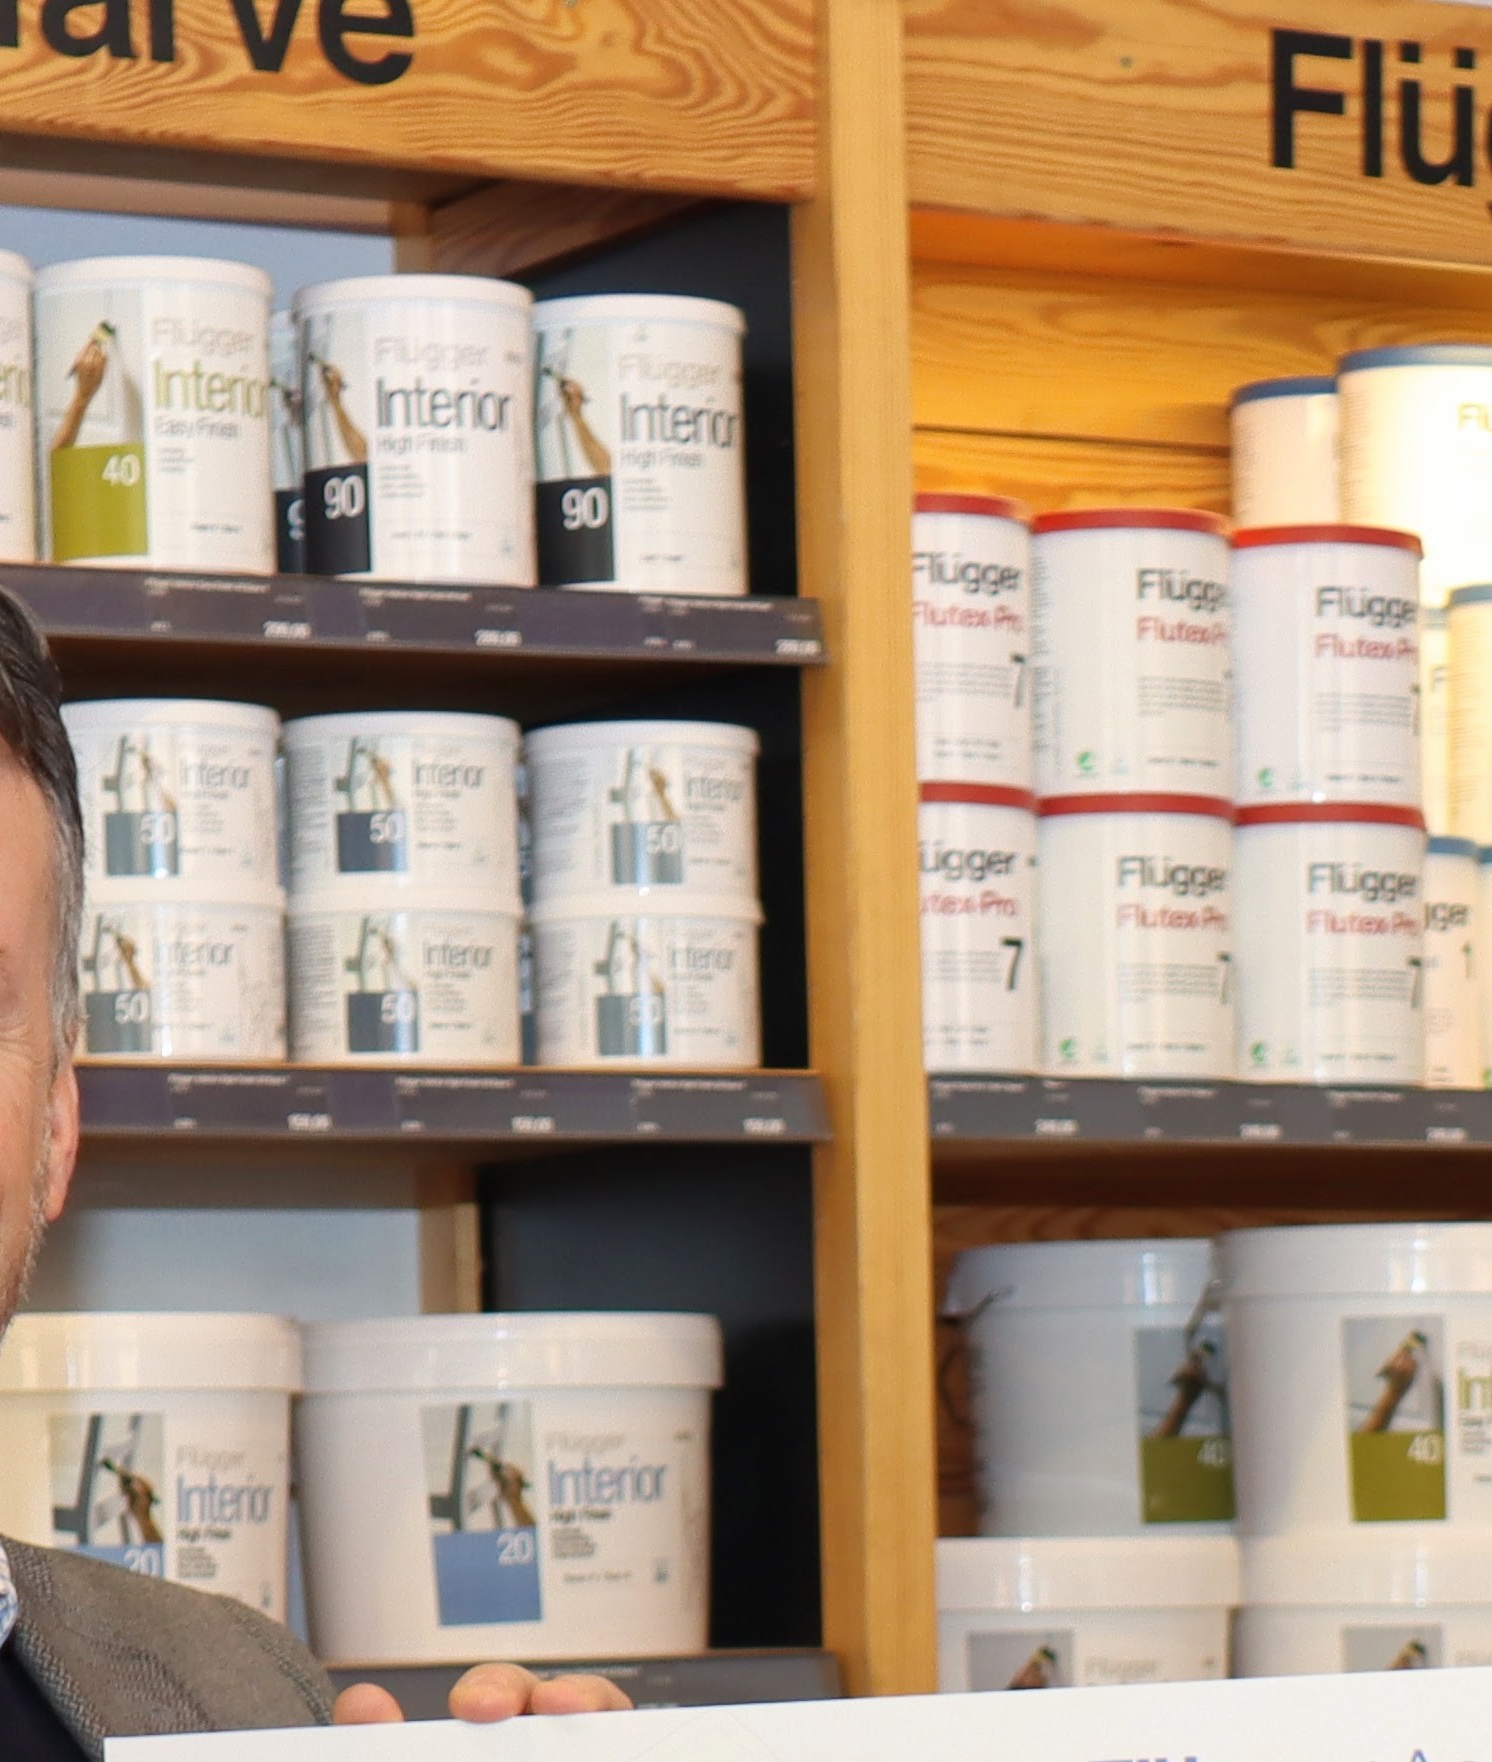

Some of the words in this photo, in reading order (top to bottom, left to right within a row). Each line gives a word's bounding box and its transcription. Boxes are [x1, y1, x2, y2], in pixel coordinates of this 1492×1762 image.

[376, 376, 509, 432] Interior
[102, 453, 141, 487] 40
[323, 475, 366, 519] 90
[561, 486, 608, 531] 90
[139, 812, 175, 845] 50
[645, 823, 681, 854] 50
[999, 936, 1025, 992] 7
[113, 992, 152, 1026] 50
[1406, 1434, 1443, 1465] 40
[547, 1455, 669, 1508] Interior
[496, 1533, 535, 1567] 20
